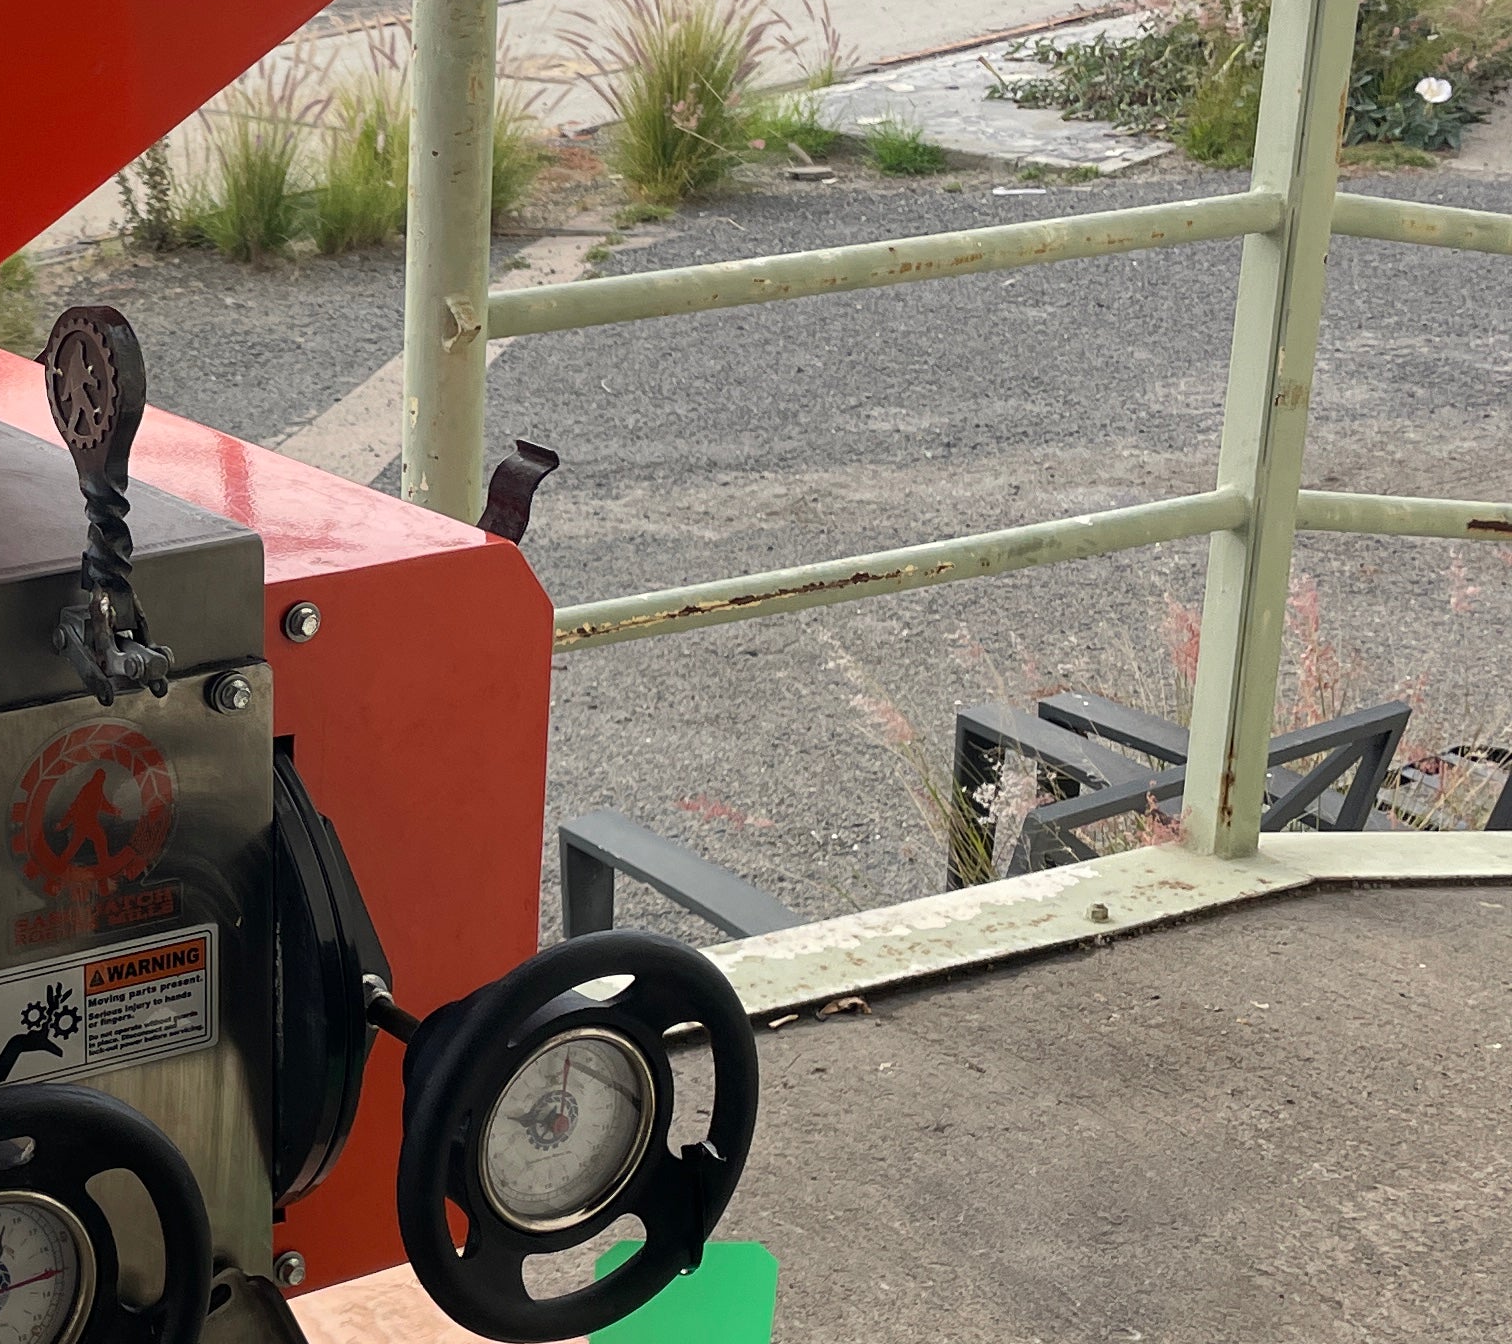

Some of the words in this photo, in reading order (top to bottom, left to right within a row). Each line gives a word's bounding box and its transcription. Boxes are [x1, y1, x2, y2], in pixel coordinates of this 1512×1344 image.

[107, 947, 200, 982] WARNING
[88, 993, 126, 1008] Moving
[129, 986, 157, 1000] parts
[160, 975, 204, 993] present.
[88, 1007, 123, 1021] Serious
[125, 1001, 151, 1013] injury
[153, 997, 163, 1006] to
[165, 991, 192, 1003] hands
[88, 1021, 98, 1029] or
[100, 1013, 135, 1026] fingers.
